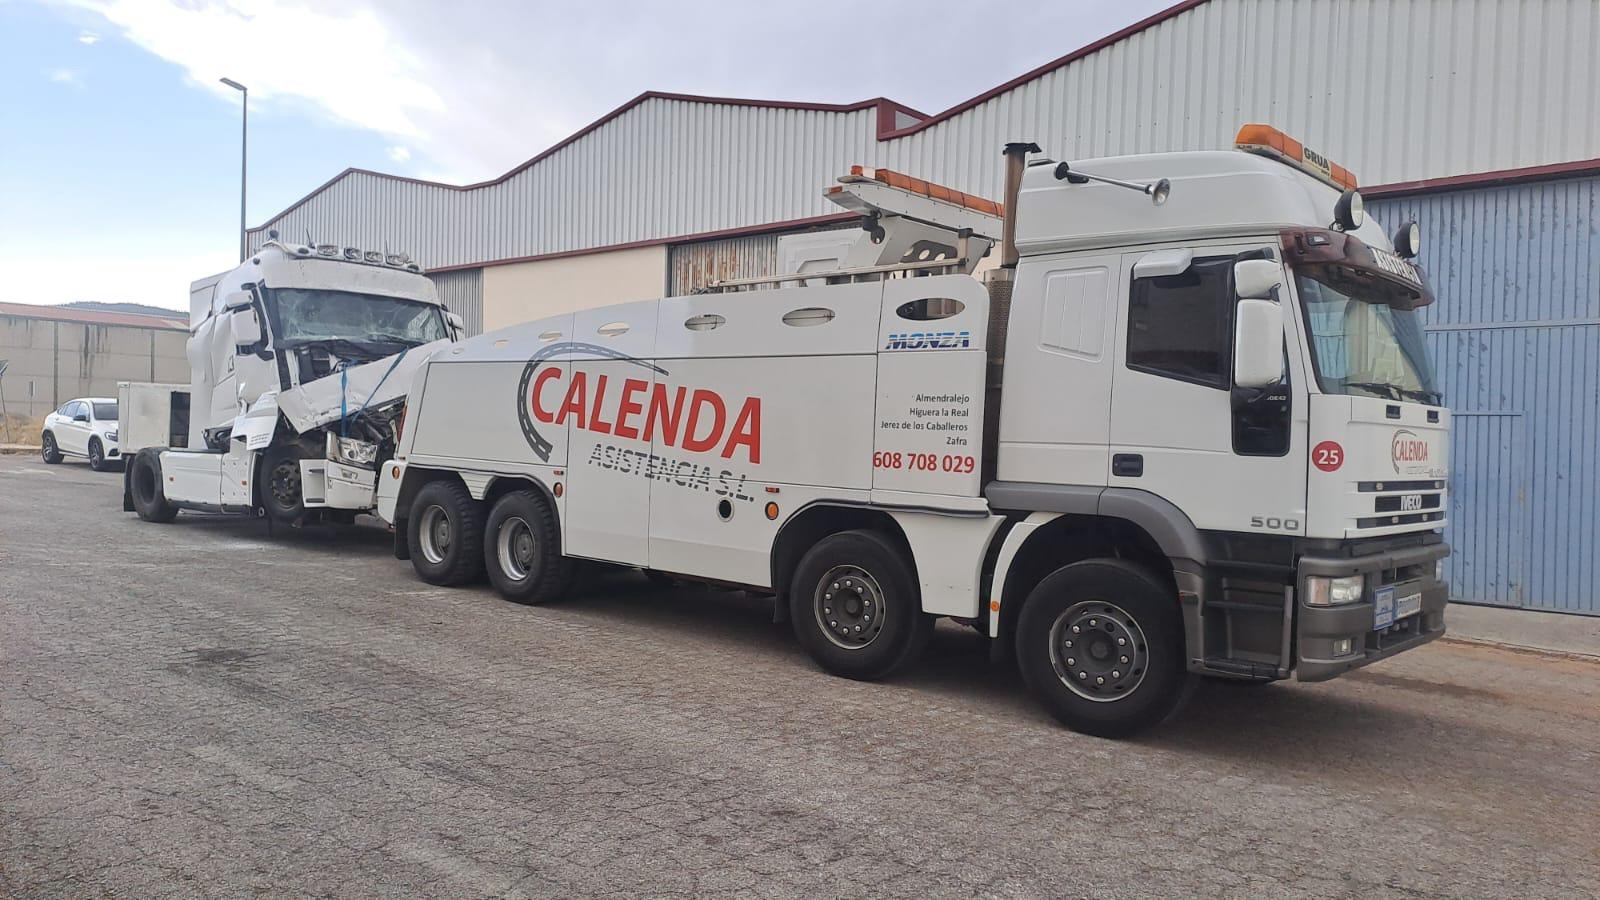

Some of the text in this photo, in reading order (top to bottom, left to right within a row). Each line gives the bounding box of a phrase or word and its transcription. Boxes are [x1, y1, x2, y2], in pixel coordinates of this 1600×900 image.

[1304, 147, 1330, 171] GRUA
[885, 331, 970, 349] MONZA
[915, 394, 970, 405] Almendralejo
[532, 367, 761, 464] CALENDA
[909, 407, 969, 418] Higuera la Real
[881, 420, 968, 431] Jerez de los Caballeros
[946, 436, 968, 446] Zafra
[1318, 449, 1339, 465] 25
[1394, 440, 1428, 462] CALENDA
[873, 451, 975, 474] 608 708 029
[588, 443, 755, 502] ASISTENCIA S.L.
[1401, 495, 1422, 511] IVECO
[1251, 517, 1299, 530] 500
